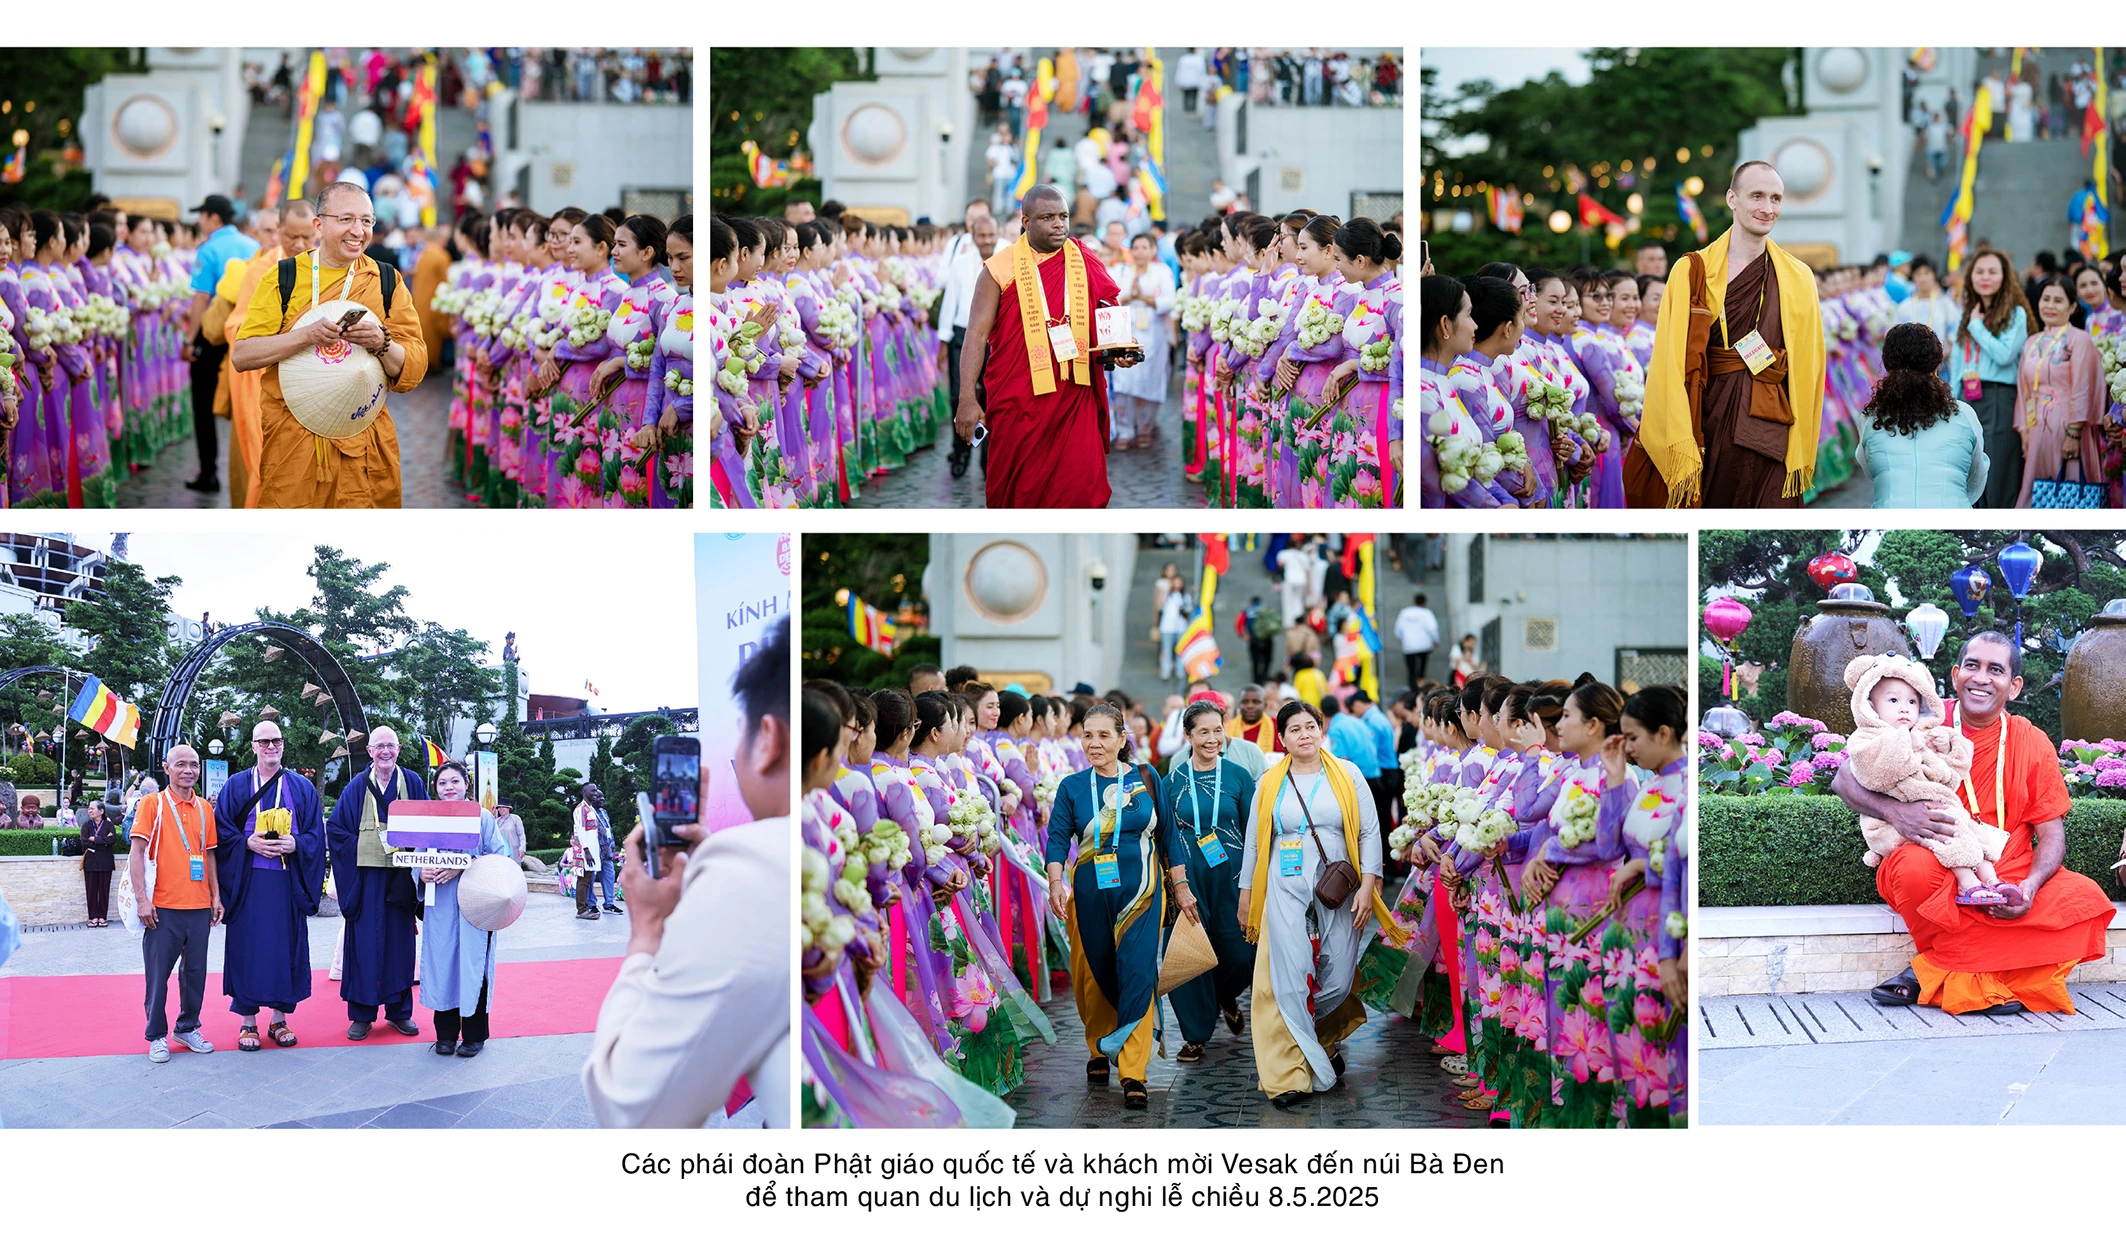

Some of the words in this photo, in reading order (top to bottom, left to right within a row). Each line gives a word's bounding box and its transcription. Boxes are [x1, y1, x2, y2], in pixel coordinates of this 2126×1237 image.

[1743, 342, 1766, 360] DELEGATE
[726, 595, 777, 630] KÍNH
[395, 854, 468, 866] NETHERLANDS
